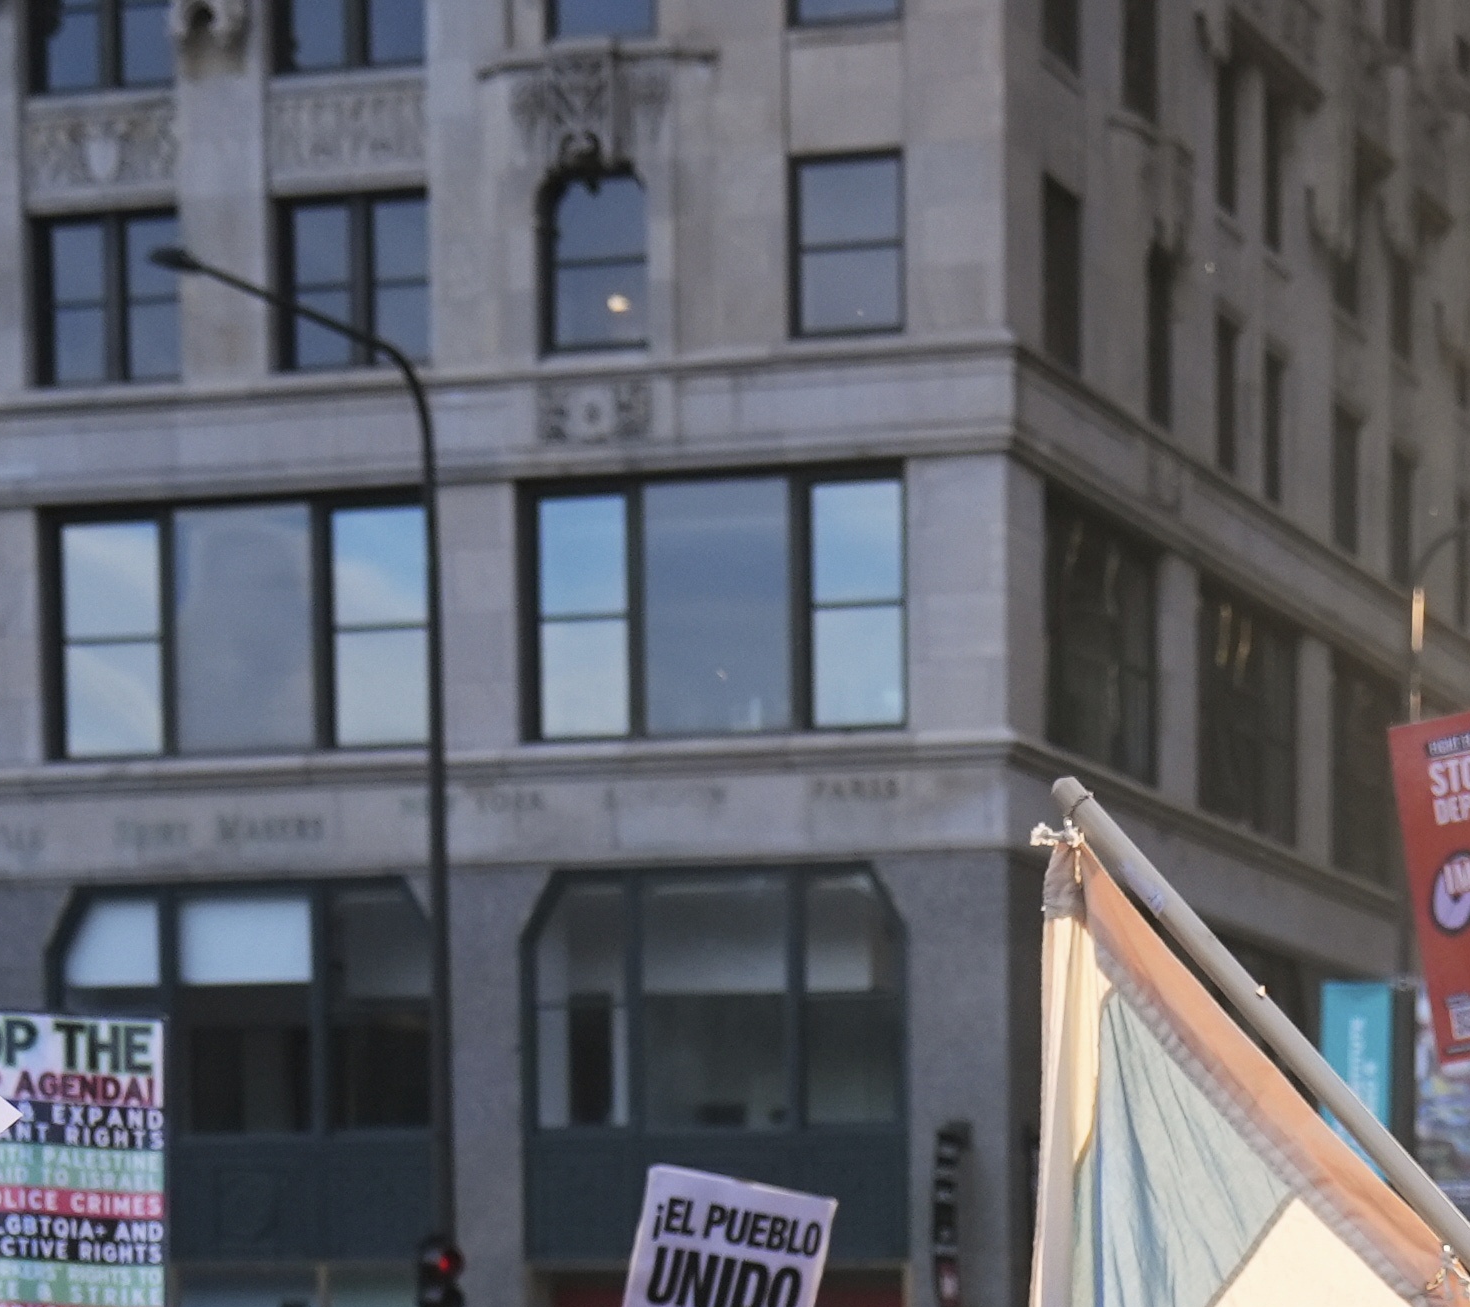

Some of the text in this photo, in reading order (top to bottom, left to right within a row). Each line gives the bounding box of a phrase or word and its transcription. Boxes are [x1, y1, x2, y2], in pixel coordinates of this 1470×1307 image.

[52, 1020, 155, 1075] THE
[14, 1070, 155, 1106] AGENDA!
[51, 1104, 165, 1130] EXPAND
[64, 1123, 165, 1150] RIGHTS
[69, 1191, 162, 1217] CRIMES
[114, 1220, 165, 1242] AND
[651, 1197, 821, 1258] ¡EL PUEBLO
[78, 1241, 163, 1265] RIGHTS
